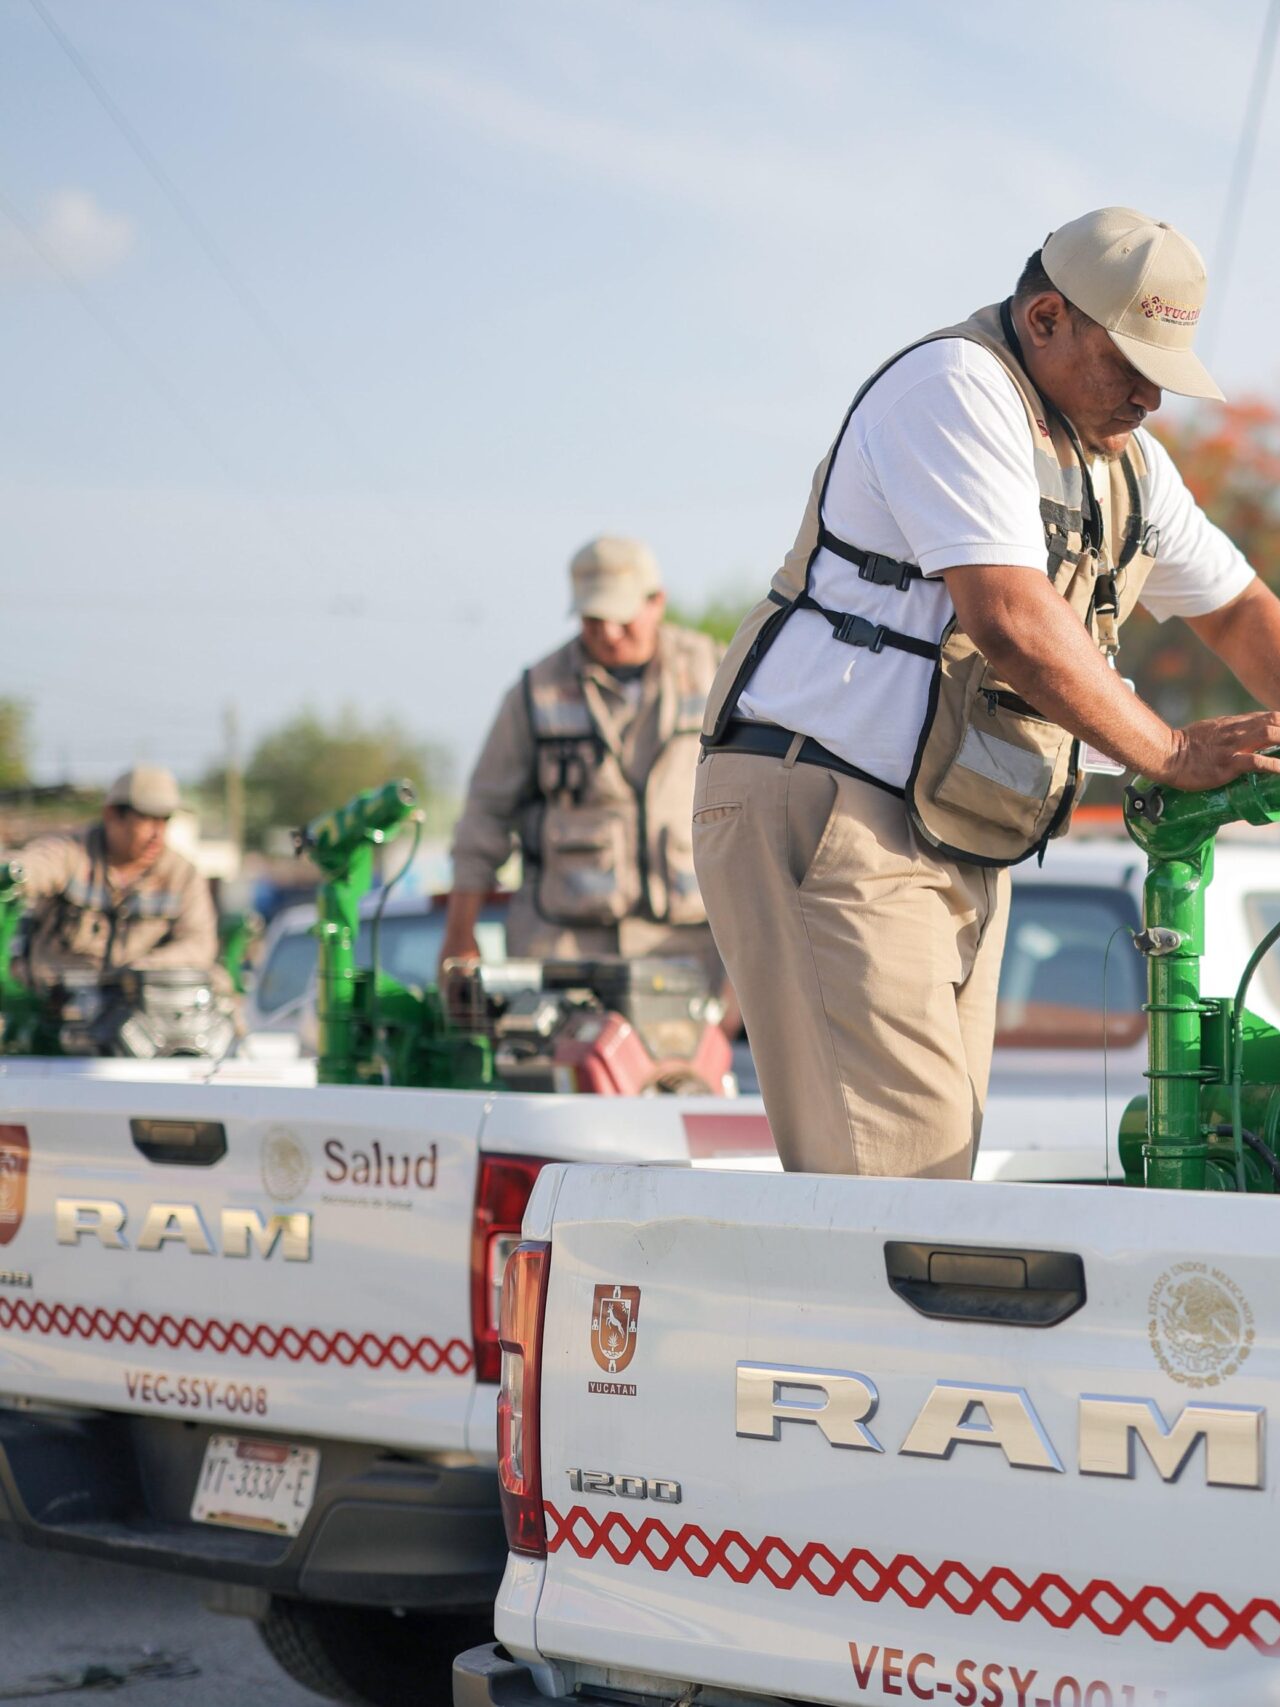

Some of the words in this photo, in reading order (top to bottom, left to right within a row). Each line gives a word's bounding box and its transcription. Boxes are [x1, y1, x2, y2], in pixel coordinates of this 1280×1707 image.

[323, 1138, 438, 1189] Salud
[55, 1198, 313, 1263] RAM
[125, 1371, 268, 1416] VEC-SSY-008
[589, 1381, 636, 1396] YUCATAN
[735, 1360, 1267, 1490] RAM
[565, 1467, 683, 1505] 1200
